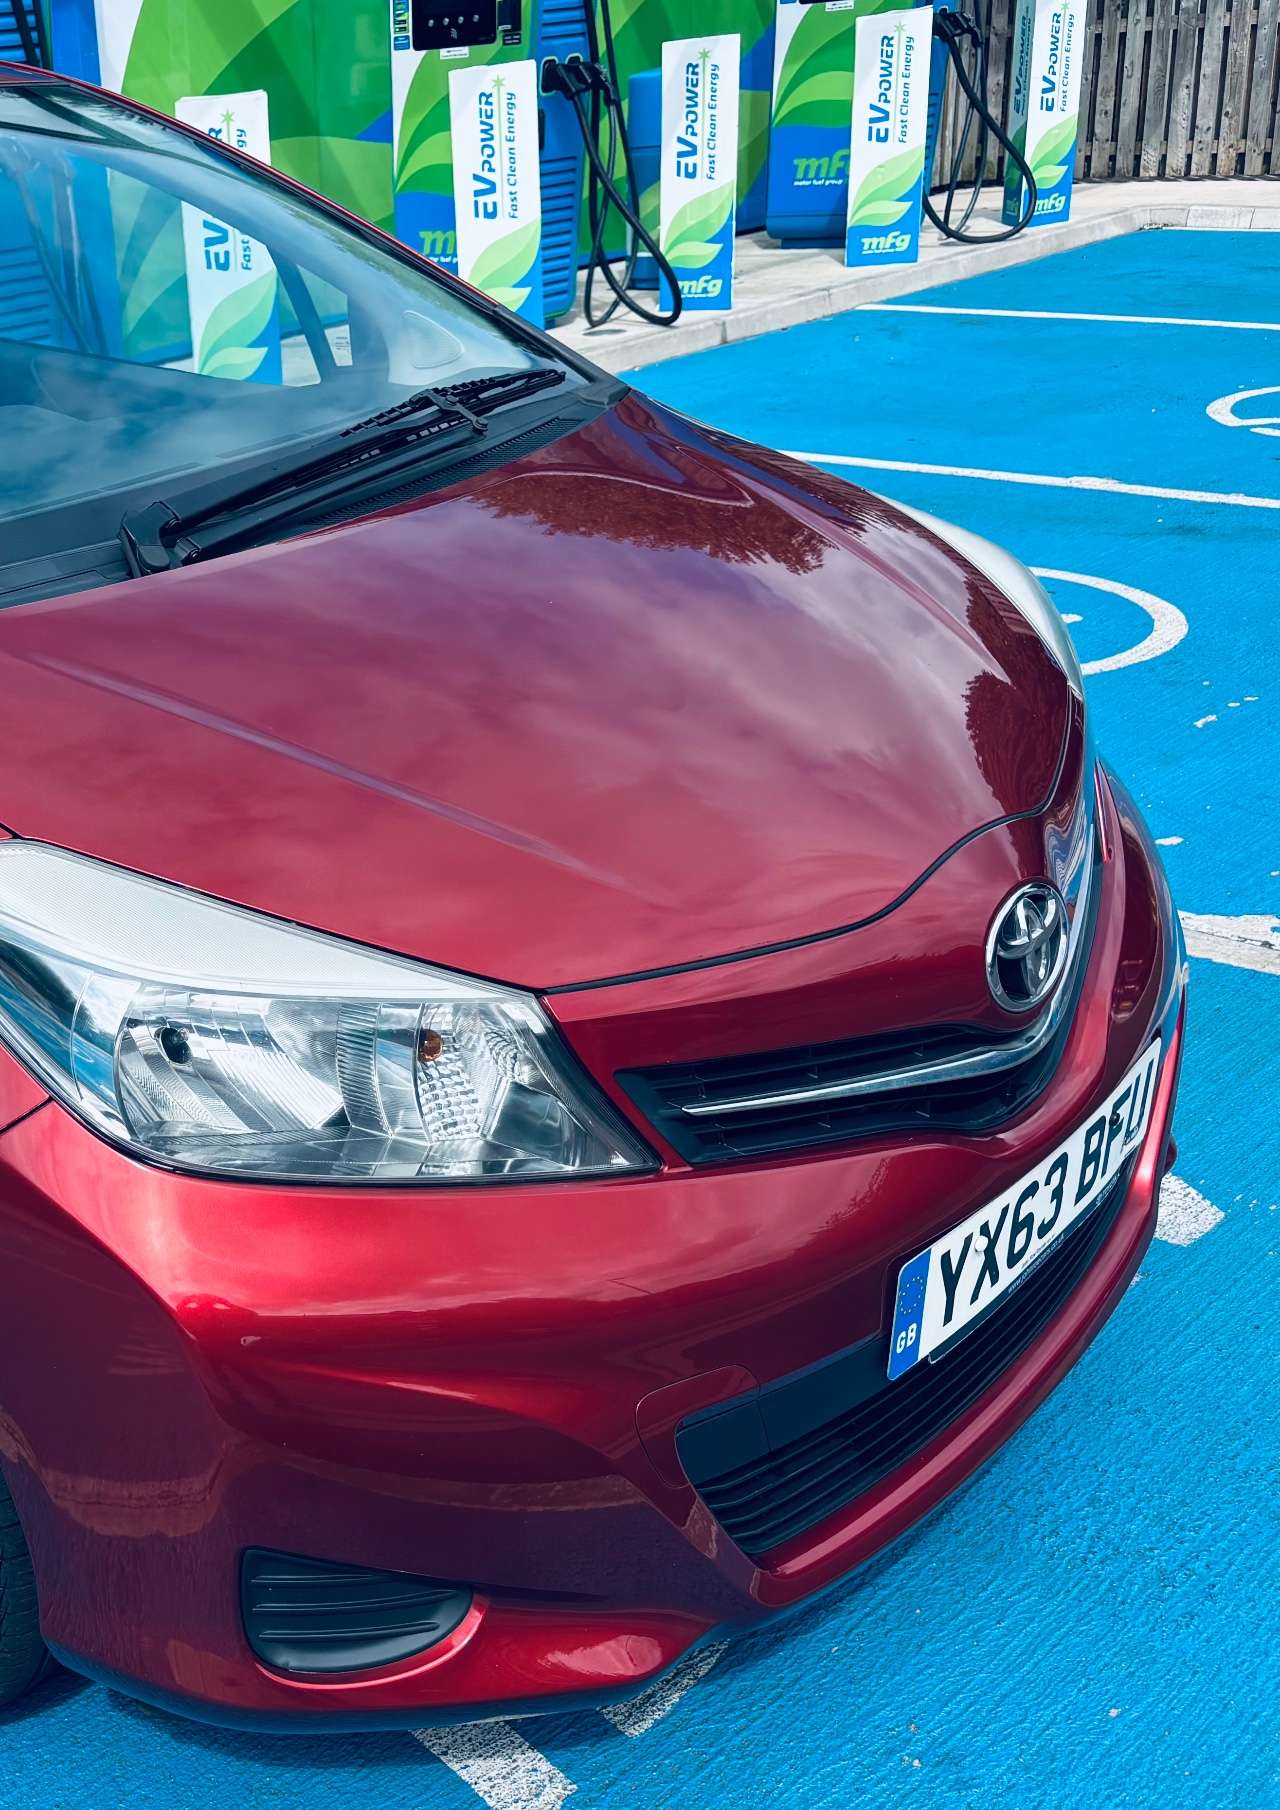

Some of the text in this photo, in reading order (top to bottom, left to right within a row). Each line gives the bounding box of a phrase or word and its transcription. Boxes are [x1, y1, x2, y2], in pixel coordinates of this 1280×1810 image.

[867, 35, 894, 143] EV POWER
[898, 36, 914, 143] Fast Clean Energy
[1040, 12, 1062, 111] EV POWER
[1060, 13, 1075, 112] Fast Clean Energy
[472, 91, 498, 220] EV POWER
[505, 92, 518, 219] Fast Clean Energy
[676, 62, 699, 180] EV POWER
[706, 63, 720, 180] Fast Clean Energy
[793, 149, 850, 179] mf
[861, 230, 911, 251] mfg
[1035, 193, 1066, 212] mfg
[678, 275, 723, 297] mfg
[940, 1151, 1068, 1327] YX63
[896, 1322, 918, 1354] GB
